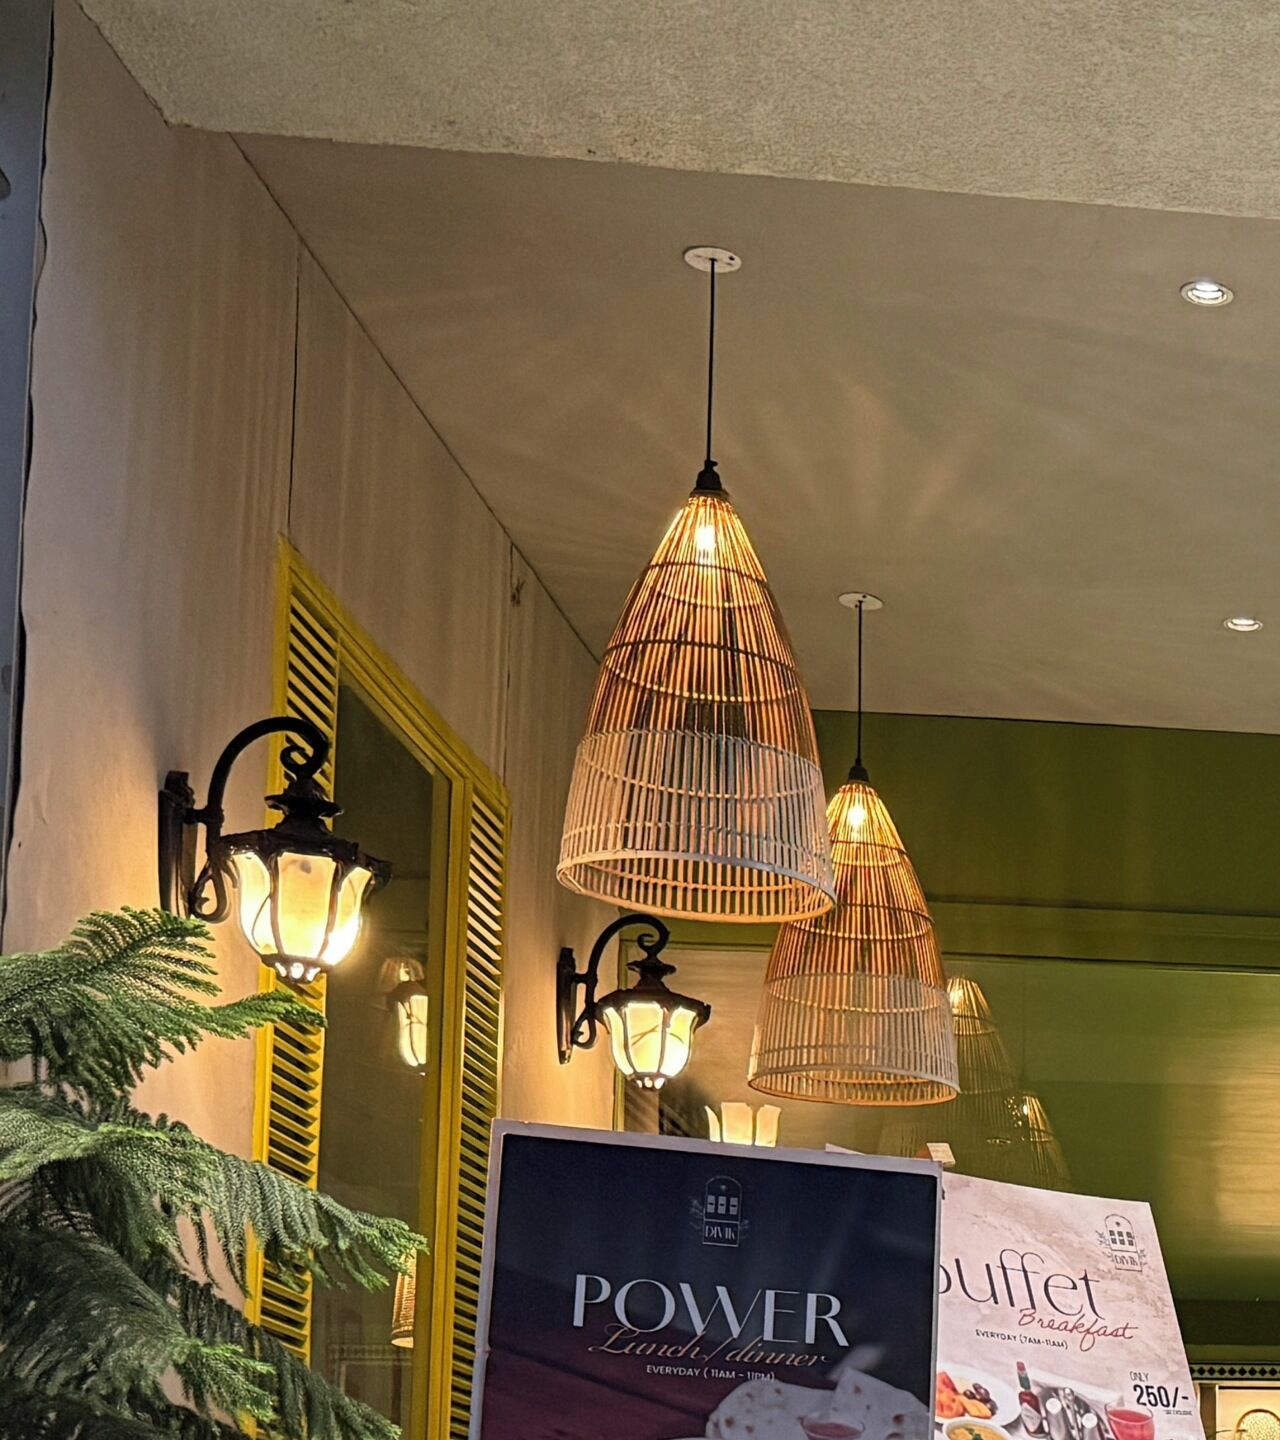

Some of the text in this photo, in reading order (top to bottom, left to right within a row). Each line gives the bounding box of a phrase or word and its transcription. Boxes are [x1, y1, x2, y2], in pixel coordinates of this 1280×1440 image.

[572, 1274, 849, 1347] POWER
[976, 1329, 1017, 1342] EVERYDAY
[1018, 1307, 1138, 1352] Breakfast
[646, 1364, 701, 1377] EVERYDAY
[1130, 1371, 1149, 1382] ONLY
[1133, 1384, 1189, 1408] 250/-
